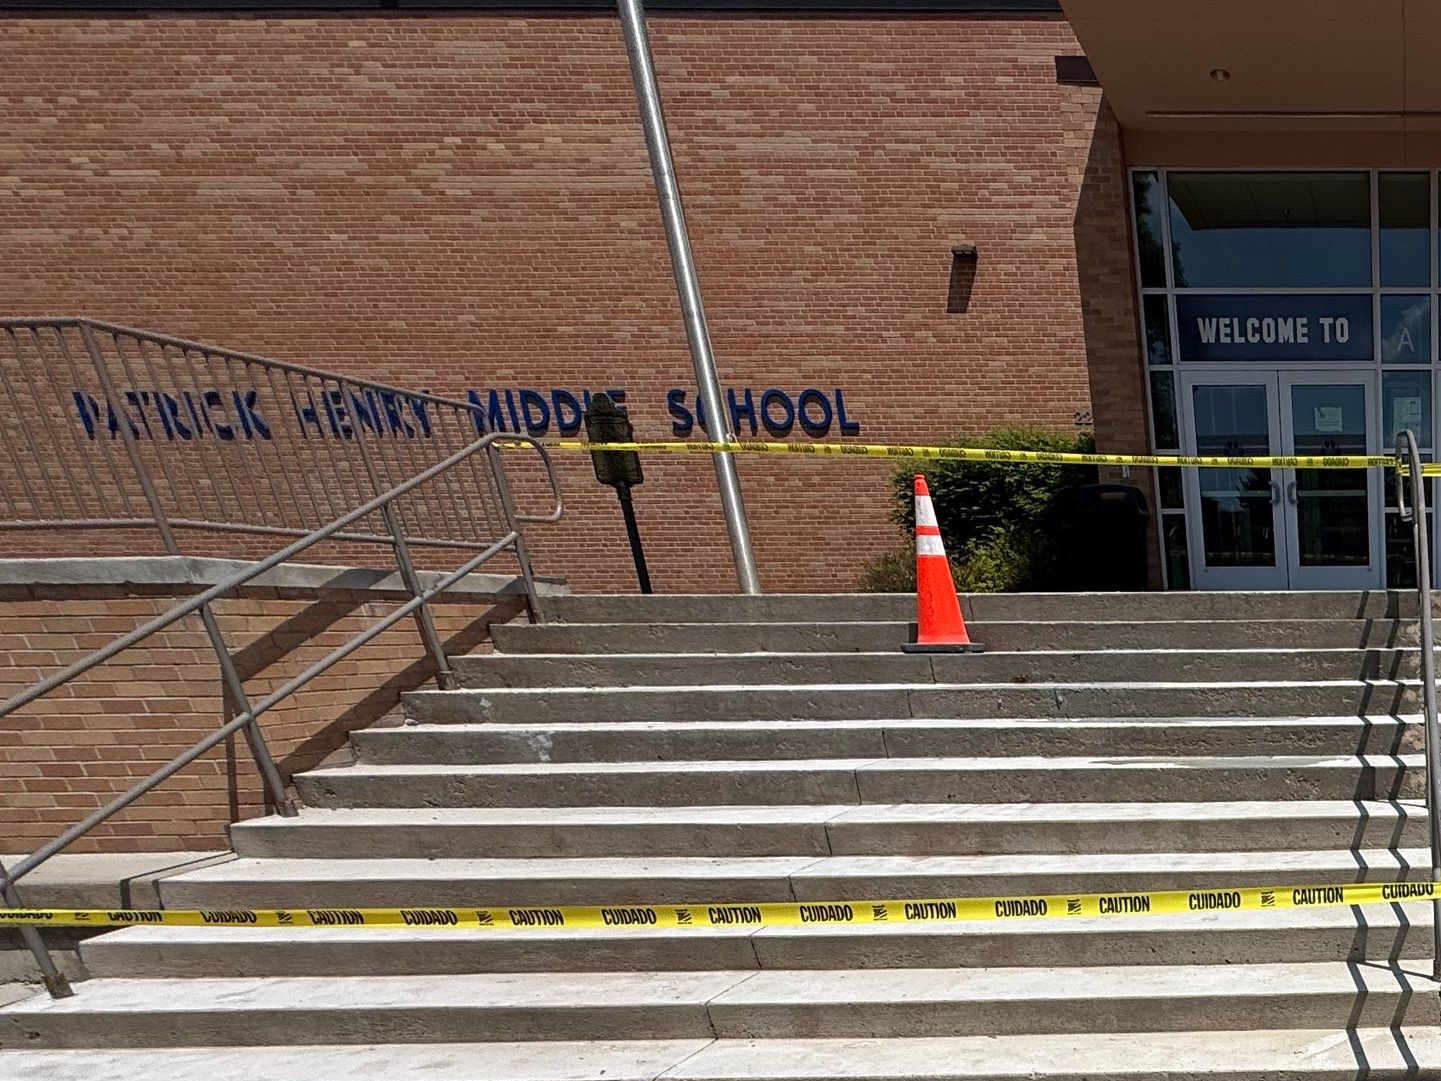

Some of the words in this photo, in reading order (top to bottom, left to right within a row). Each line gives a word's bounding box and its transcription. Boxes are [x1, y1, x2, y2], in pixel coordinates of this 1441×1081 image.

[1197, 317, 1309, 344] WELCOME
[1319, 317, 1350, 344] TO
[1397, 327, 1415, 353] A
[199, 910, 257, 923] CUIDADO
[307, 910, 364, 925] CAUTION
[400, 910, 458, 926] CUIDADO
[509, 909, 564, 926] CAUTION
[601, 908, 657, 925] CUIDADO
[708, 907, 761, 923] CAUTION
[800, 904, 853, 922] CUIDADO
[905, 902, 957, 920] CAUTION
[995, 899, 1048, 917] CUIDADO
[1099, 895, 1150, 914] CAUTION
[1189, 892, 1241, 910] CUIDADO
[1293, 887, 1344, 905] CAUTION
[1382, 883, 1434, 899] CUIDADO
